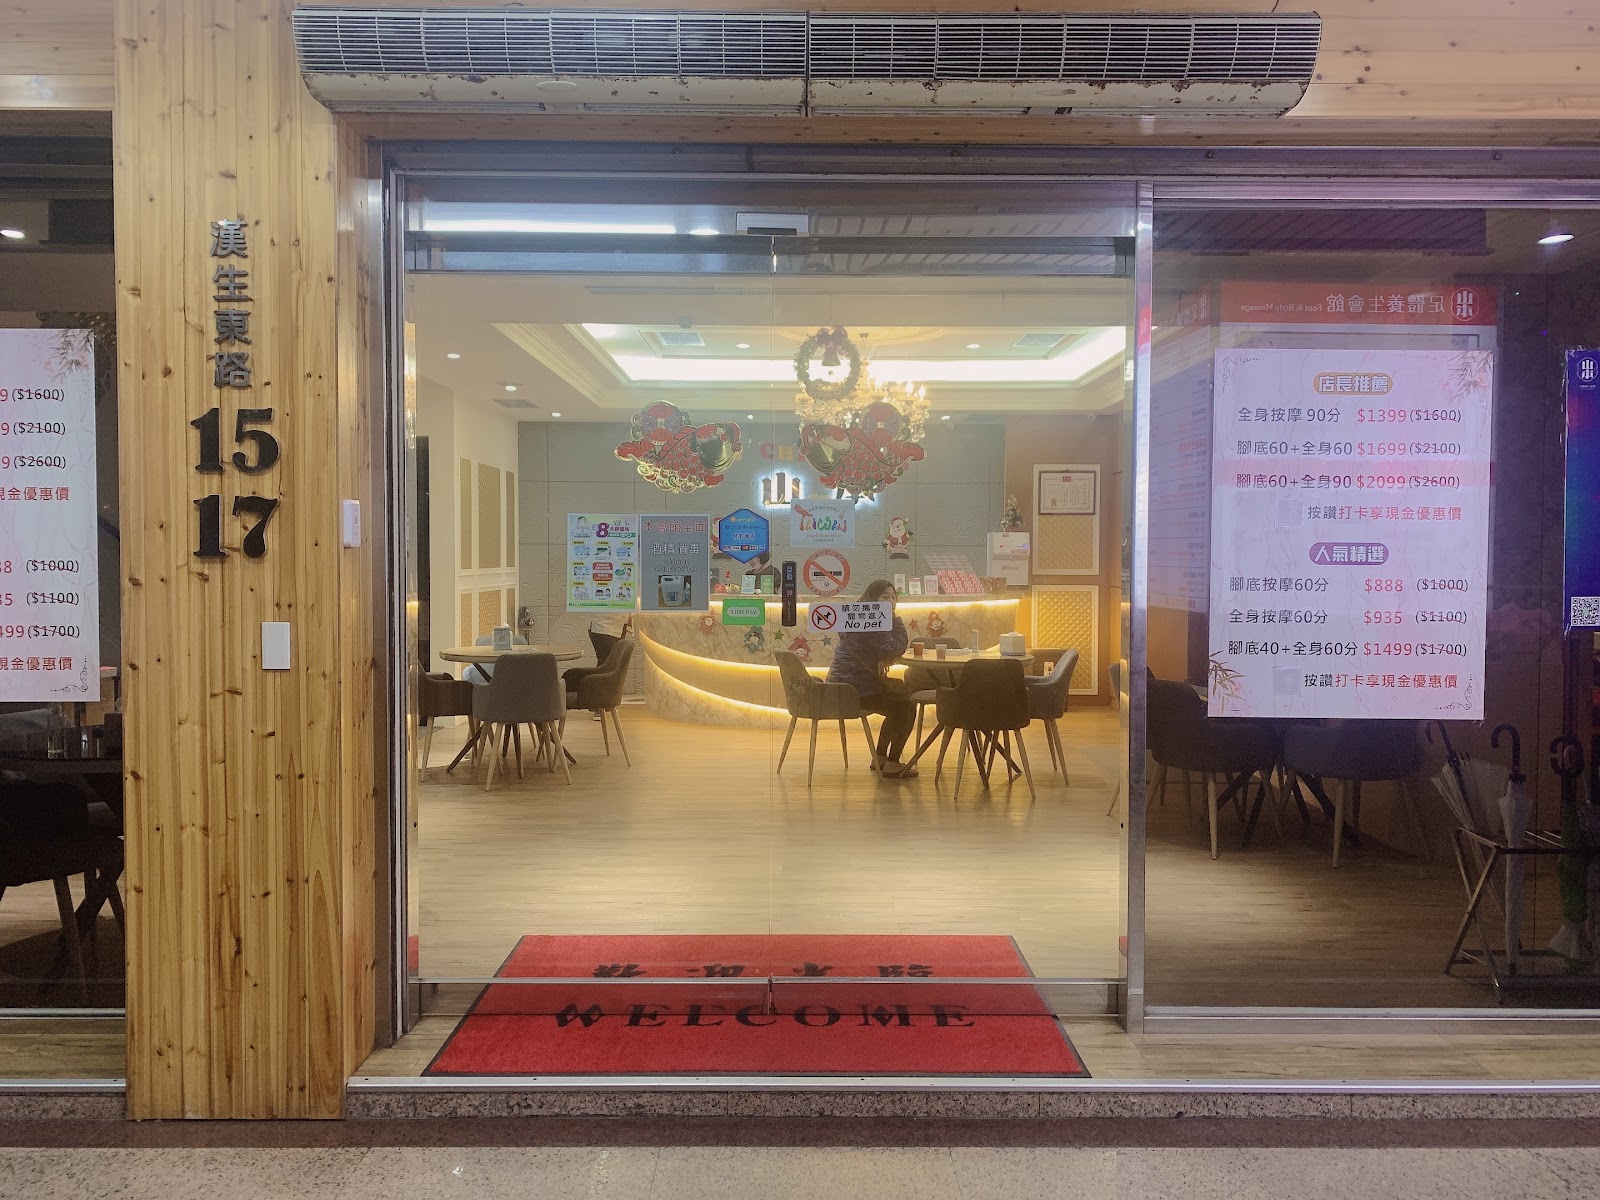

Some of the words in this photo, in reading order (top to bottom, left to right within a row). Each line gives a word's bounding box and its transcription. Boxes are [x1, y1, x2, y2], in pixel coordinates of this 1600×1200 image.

[210, 219, 252, 389] 漢生東路
[1318, 376, 1389, 392] 店長推薦
[12, 388, 65, 402] ($1600)
[1357, 408, 1406, 424] $1399
[1409, 408, 1462, 423] ($1600)
[13, 422, 66, 435] ($2100)
[191, 407, 281, 473] 15
[1236, 440, 1353, 456] 腳底60+全身60
[1357, 440, 1406, 456] $1699
[1409, 442, 1461, 456] ($2100)
[14, 456, 66, 469] ($2600)
[1236, 474, 1352, 489] 腳底60+全身90
[1356, 474, 1406, 490] $2099
[1408, 475, 1460, 489] ($2600)
[1307, 505, 1462, 521] 按讚打卡享現金優惠價
[193, 494, 280, 558] 17
[643, 520, 707, 532] 本會館全面
[650, 543, 701, 555] 酒精消毒
[1314, 545, 1384, 562] 人氣精選
[0, 560, 12, 573] 8
[26, 560, 79, 573] ($1000)
[1229, 577, 1329, 592] 腳底按摩60分
[1364, 577, 1404, 593] $888
[1416, 578, 1468, 592] ($1000)
[0, 593, 13, 606] 5
[27, 592, 79, 606] ($1100)
[1229, 608, 1328, 624] 全身按摩60分
[1363, 609, 1403, 625] $935
[1415, 610, 1468, 624] ($1100)
[0, 625, 24, 638] 99
[28, 625, 80, 639] ($1700)
[845, 621, 860, 629] No
[864, 620, 882, 630] pet
[1228, 641, 1358, 656] 腳底40+全身60分
[1363, 641, 1413, 657] $1499
[1415, 642, 1467, 656] ($1700)
[1304, 673, 1458, 689] 按讚打卡享現金優惠價
[554, 1003, 976, 1027] WELCOME
